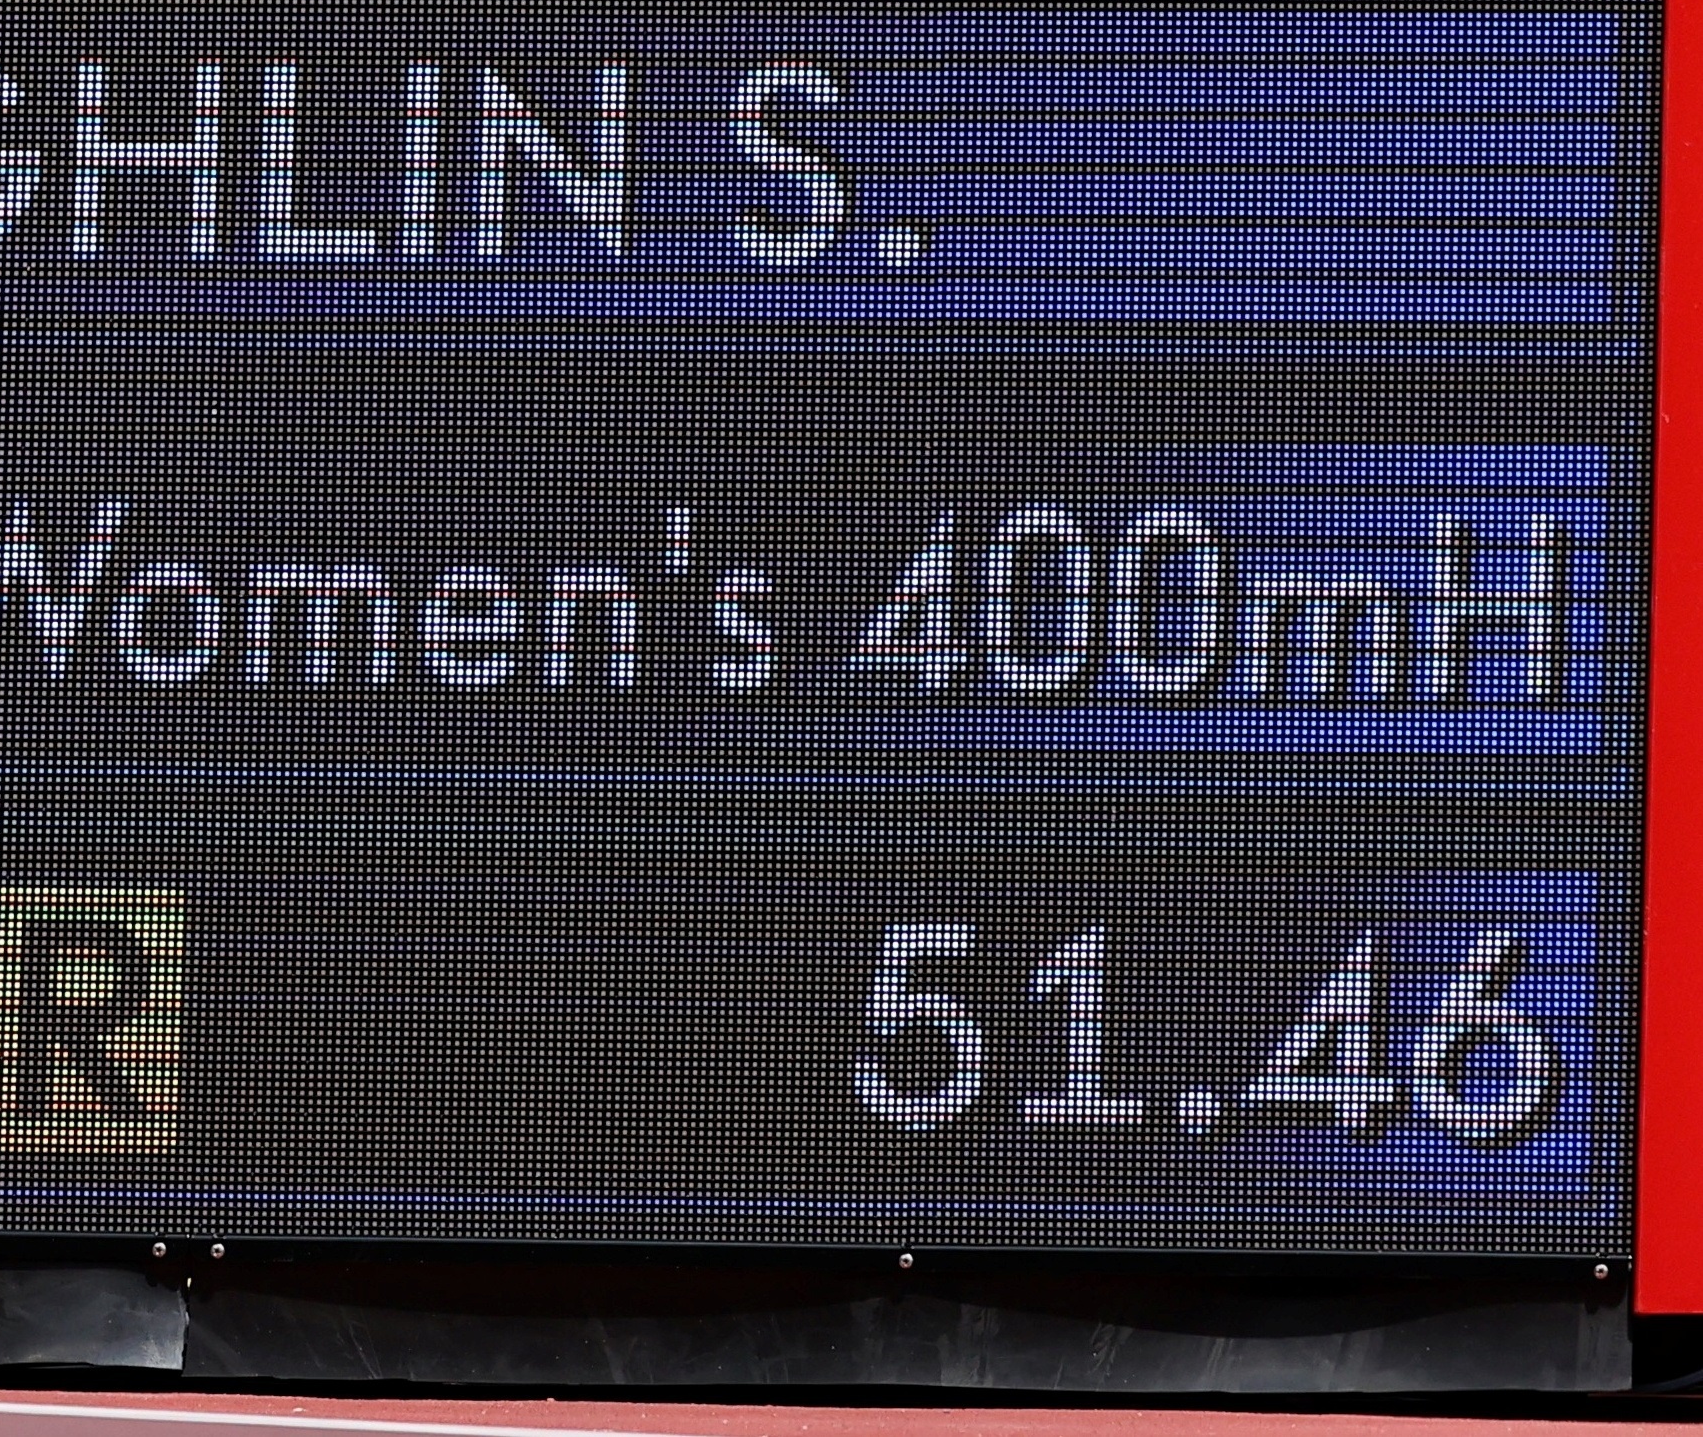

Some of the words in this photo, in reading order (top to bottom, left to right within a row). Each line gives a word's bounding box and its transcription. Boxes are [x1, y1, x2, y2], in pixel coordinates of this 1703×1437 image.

[730, 60, 924, 265] S.
[850, 503, 1558, 696] 400mH
[854, 924, 1552, 1138] 51.46
